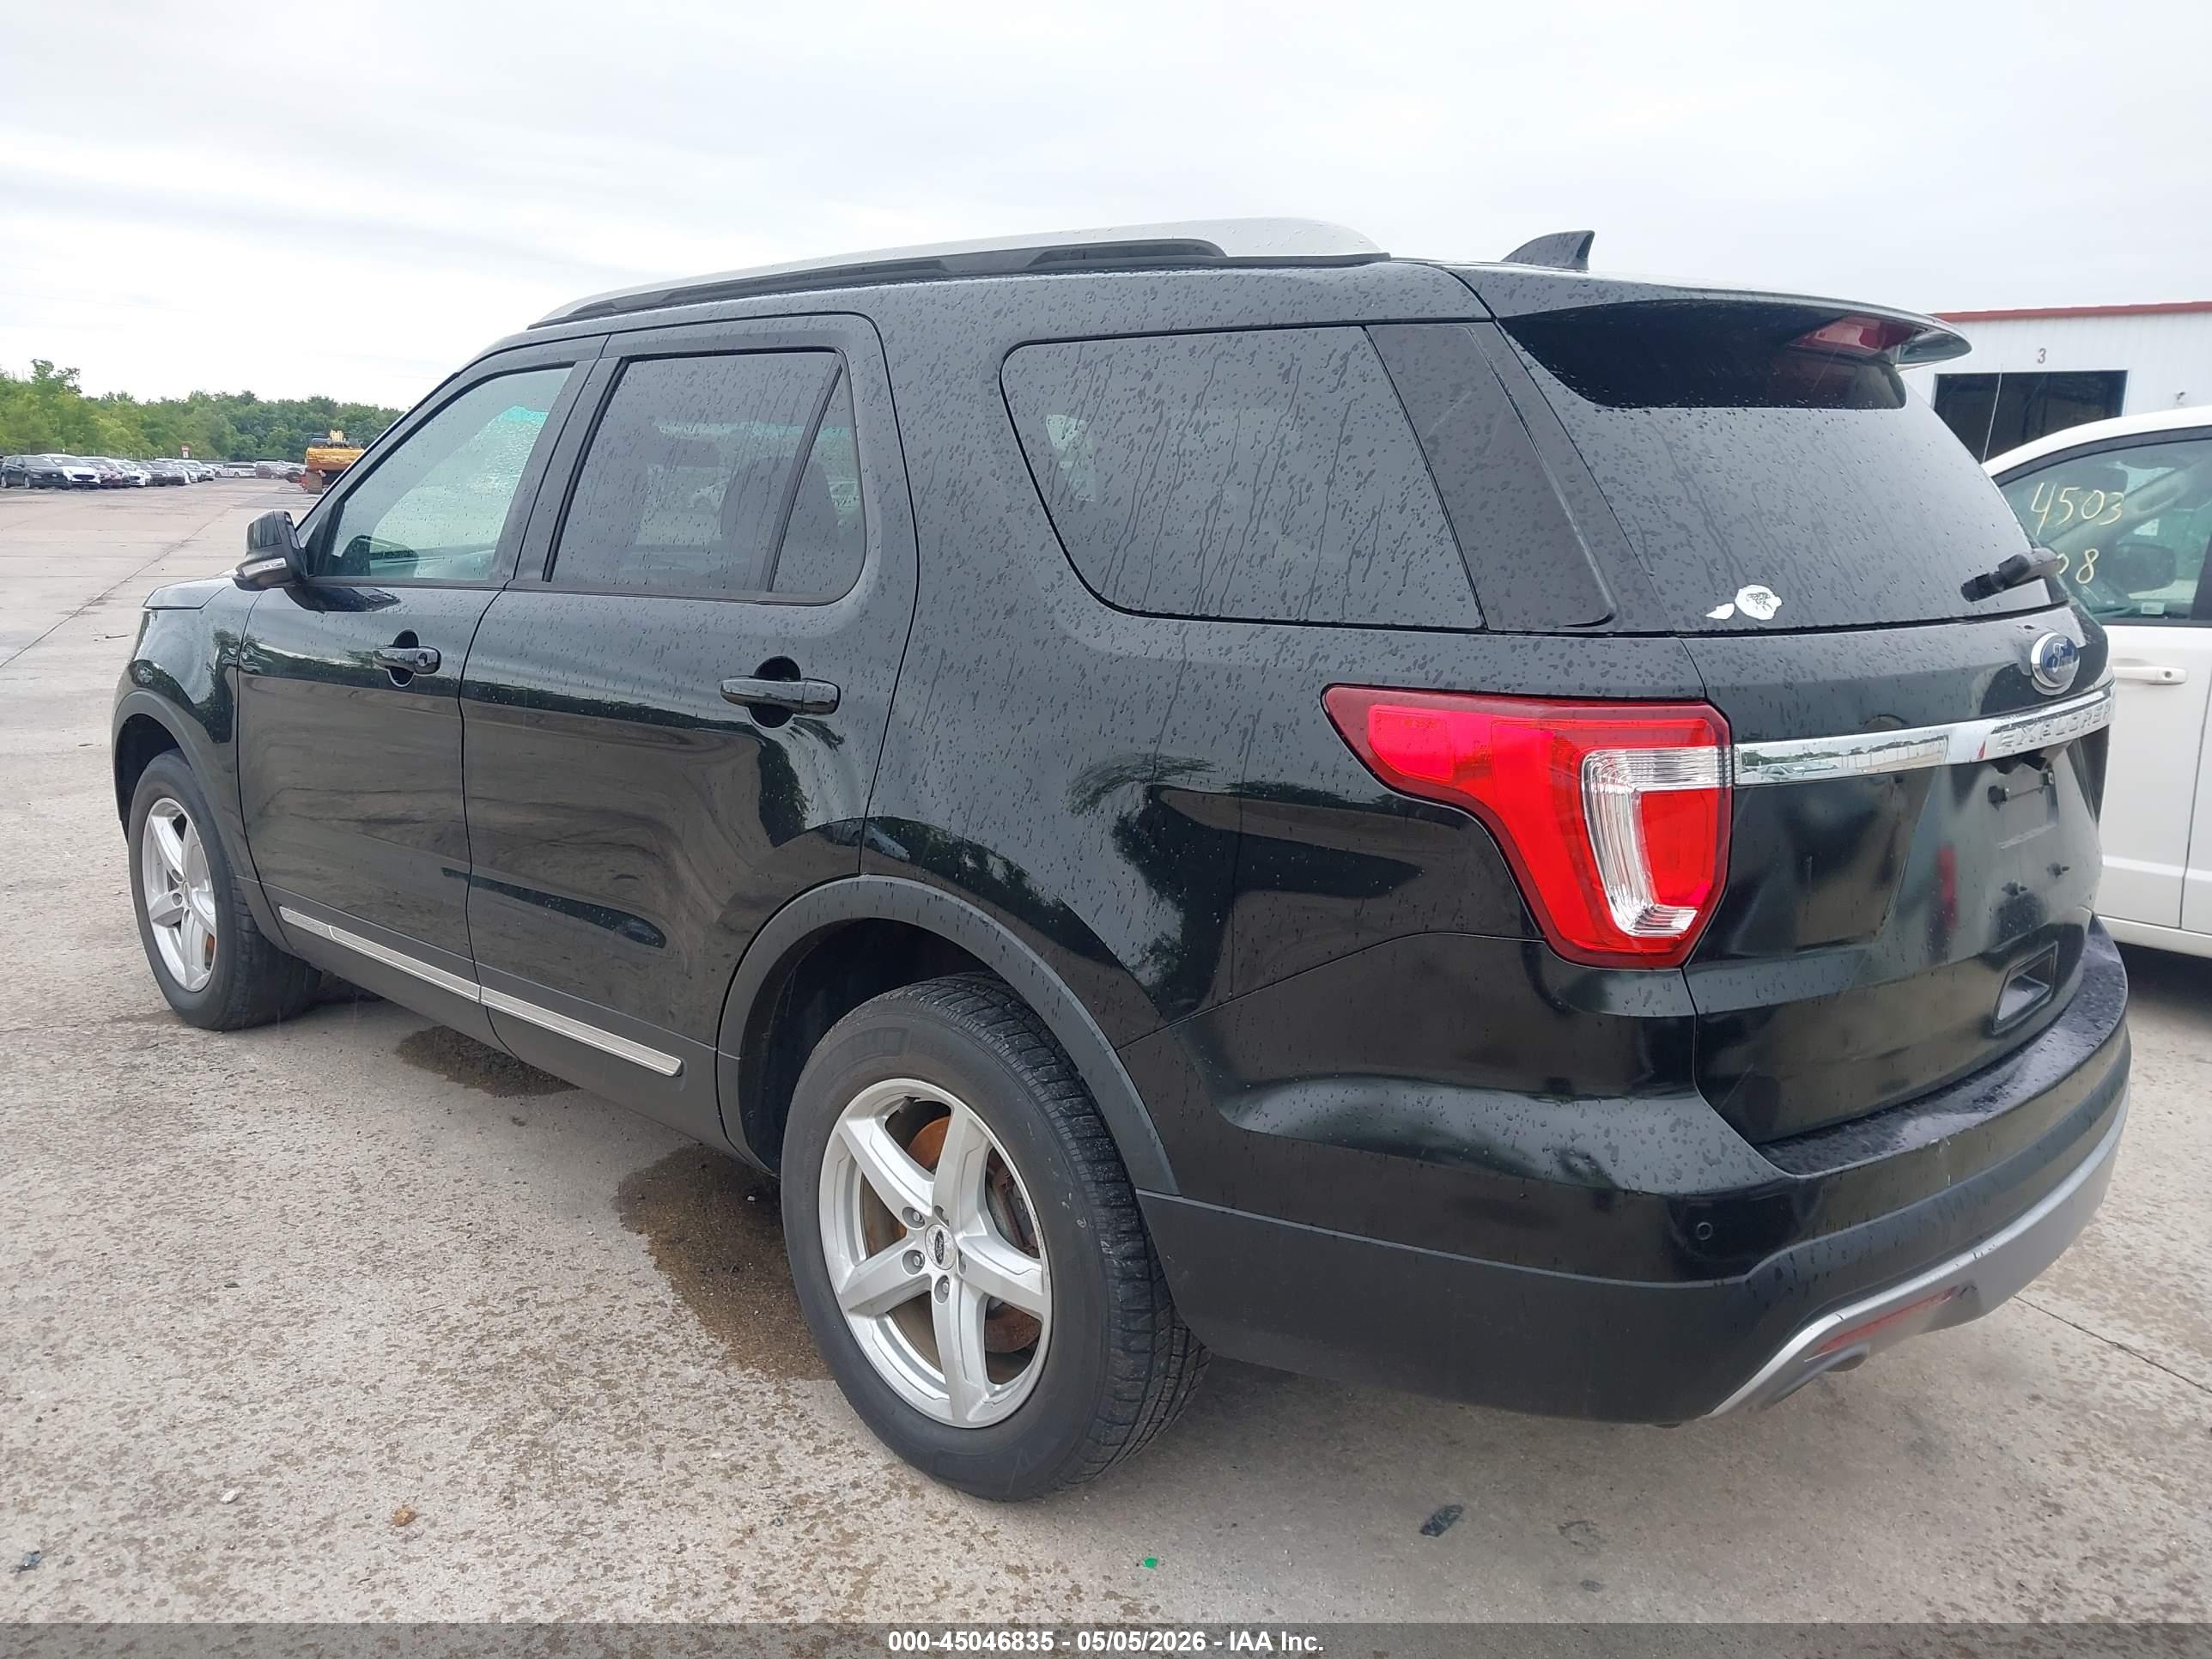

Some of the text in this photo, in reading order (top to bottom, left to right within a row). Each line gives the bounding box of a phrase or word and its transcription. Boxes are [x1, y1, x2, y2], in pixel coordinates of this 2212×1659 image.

[2037, 347, 2047, 364] 3
[2030, 482, 2125, 537] 4503
[1996, 702, 2111, 750] EXPLORER
